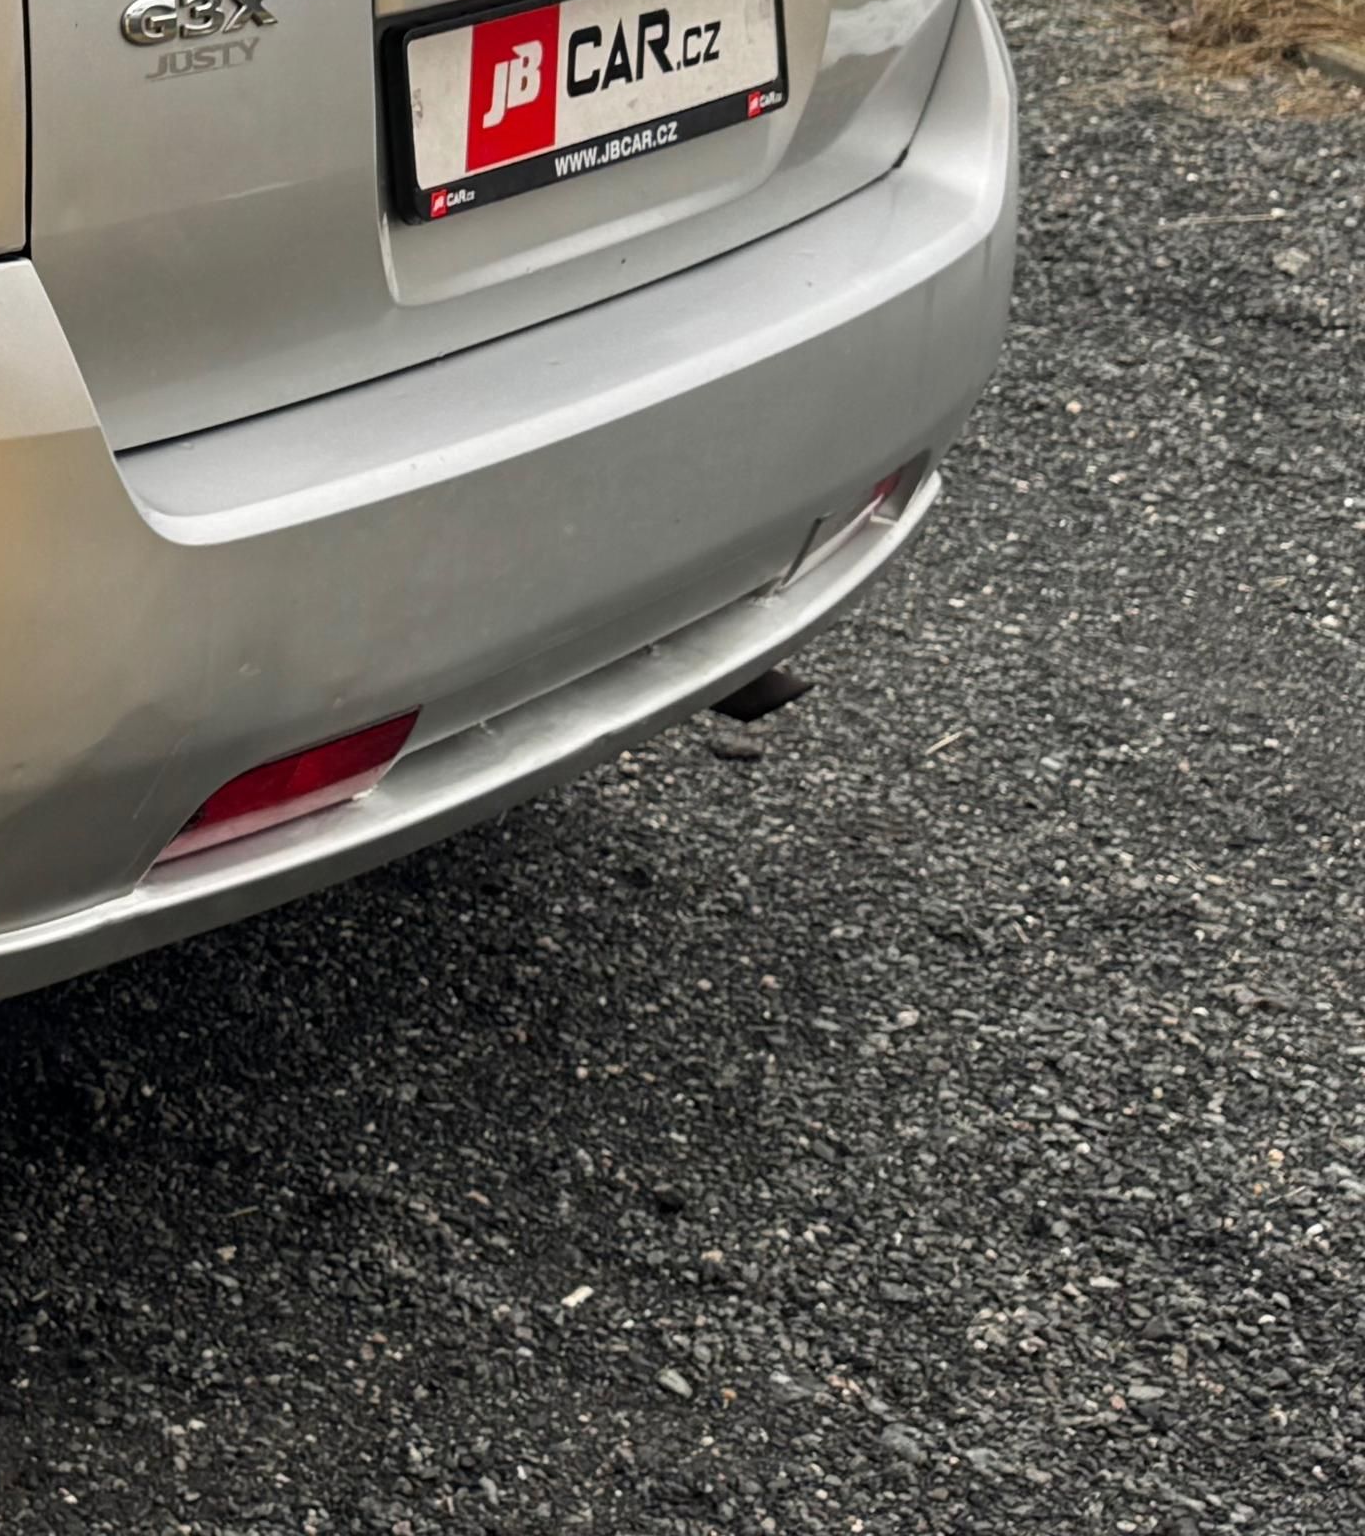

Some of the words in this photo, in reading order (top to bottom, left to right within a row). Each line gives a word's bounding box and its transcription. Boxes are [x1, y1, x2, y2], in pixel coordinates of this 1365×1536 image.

[145, 36, 260, 81] JUSTY
[482, 39, 543, 129] JB
[554, 121, 678, 177] WWW.JBCAR.CZ
